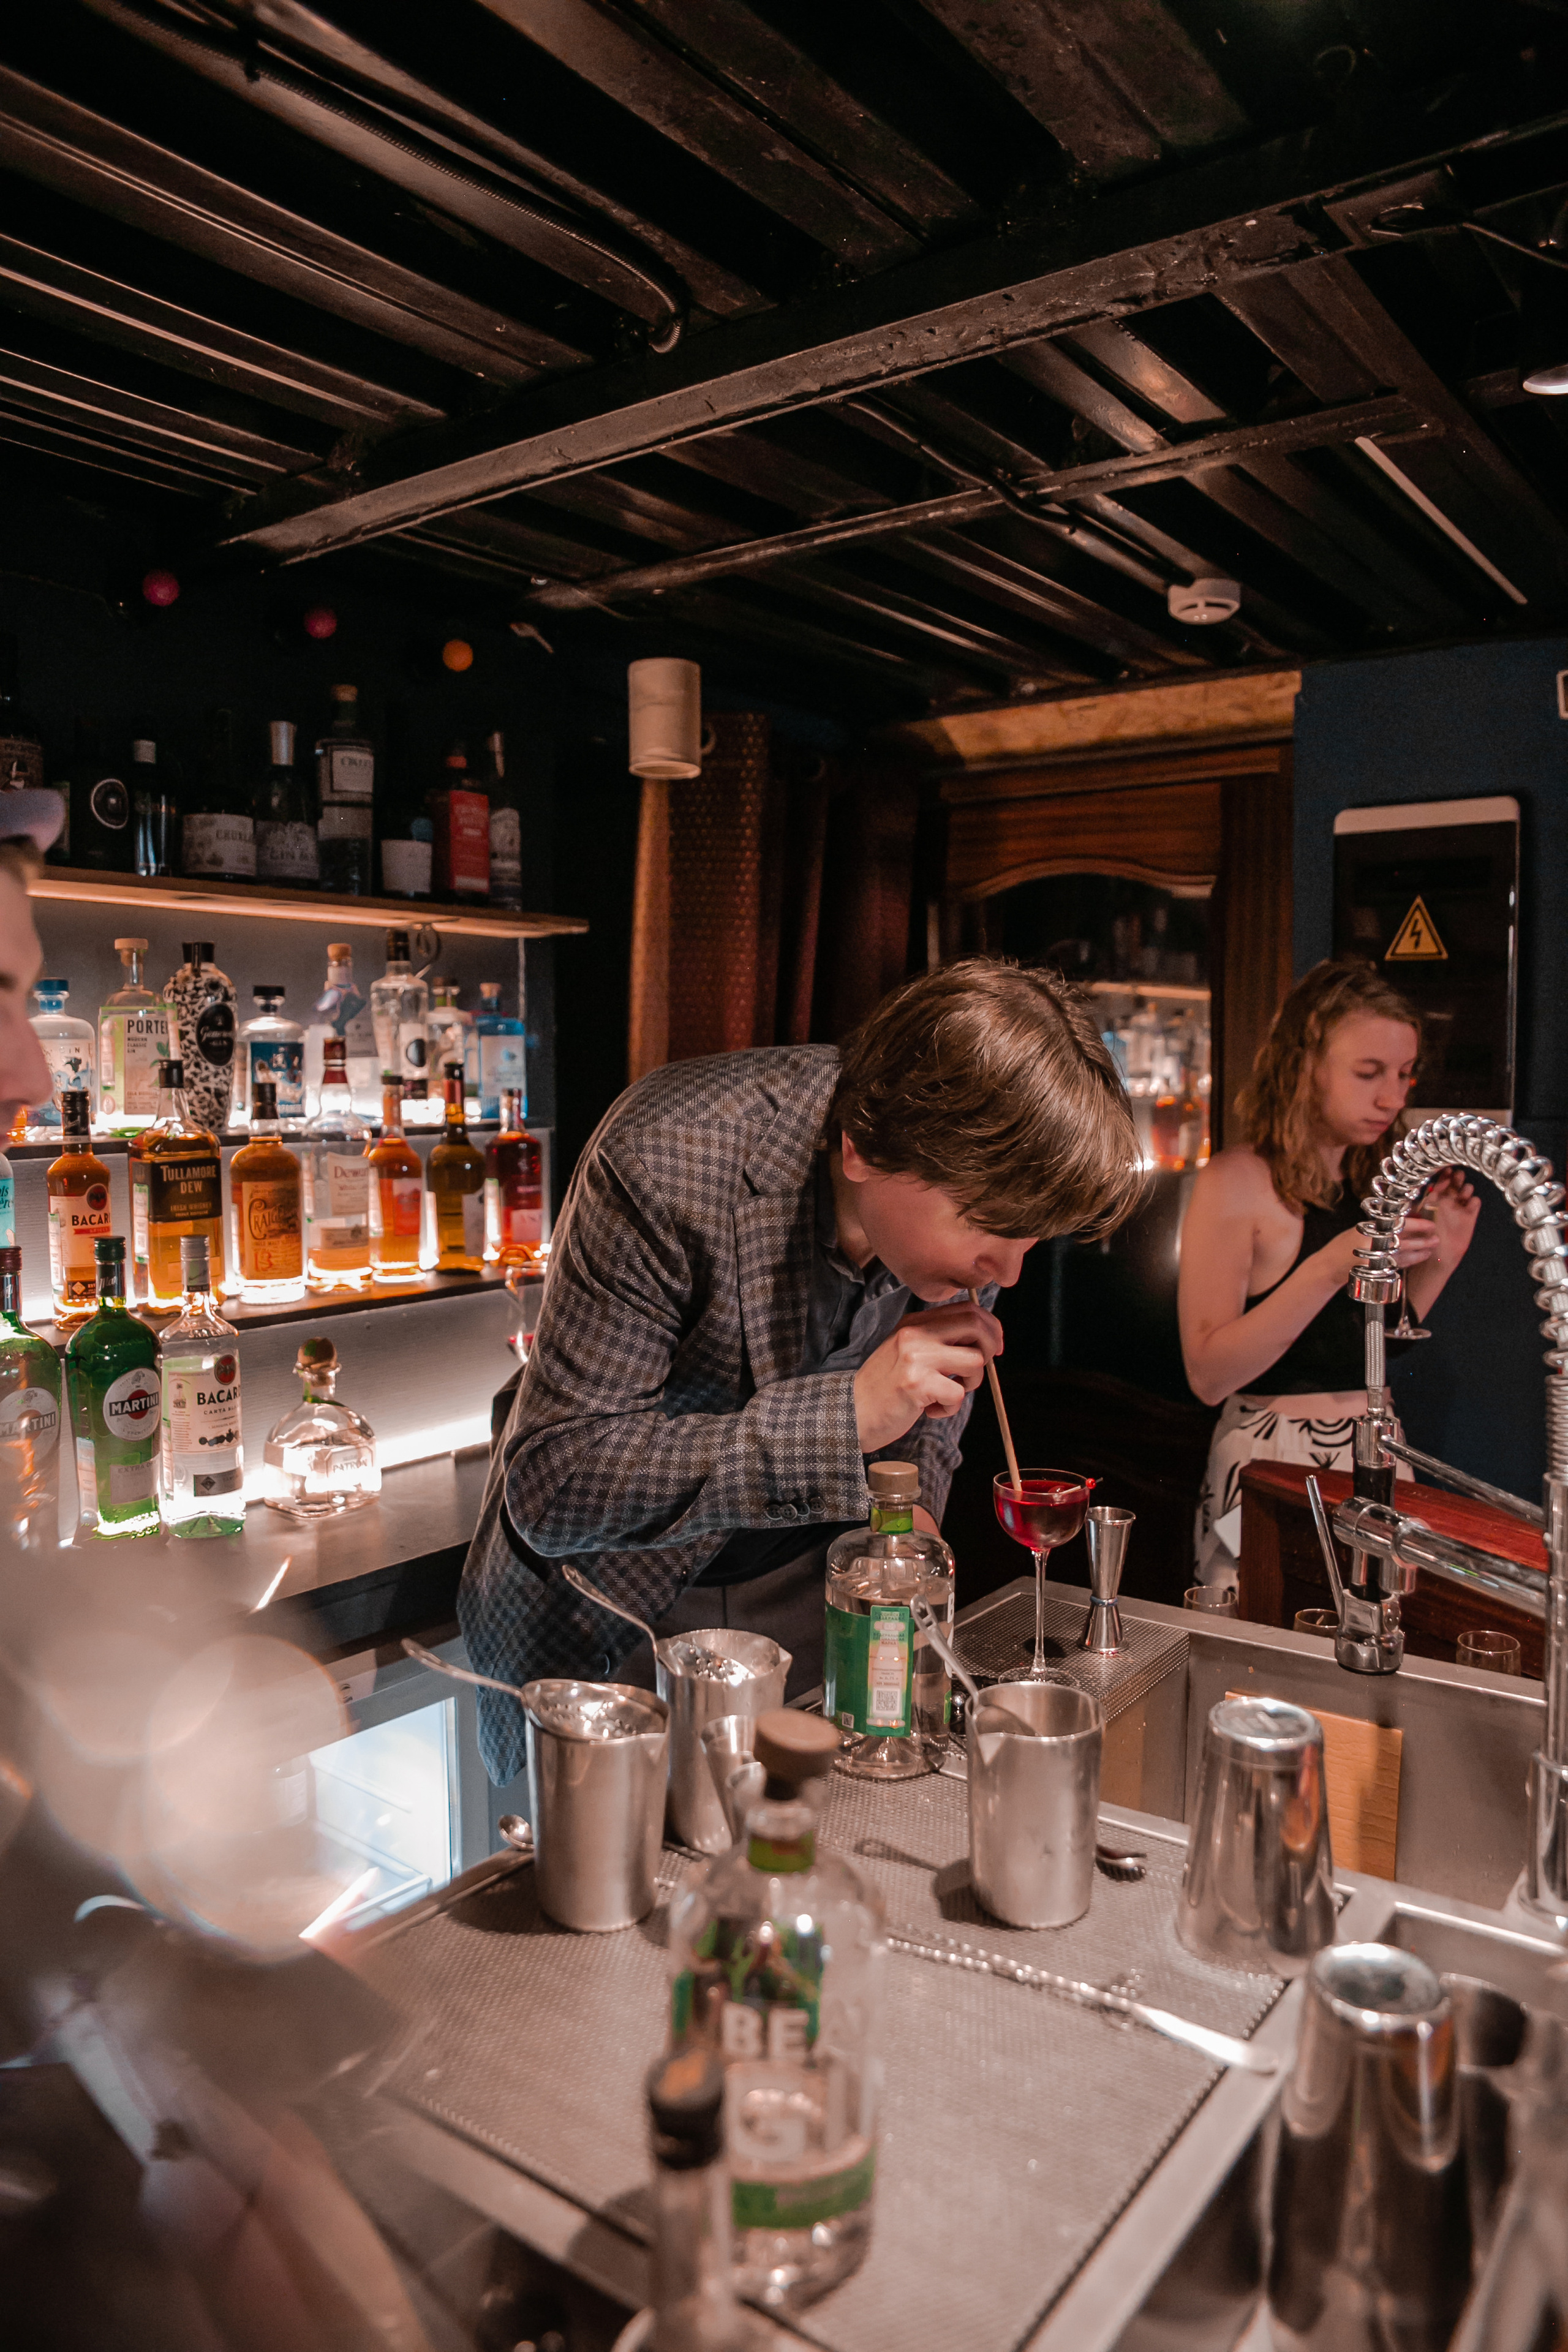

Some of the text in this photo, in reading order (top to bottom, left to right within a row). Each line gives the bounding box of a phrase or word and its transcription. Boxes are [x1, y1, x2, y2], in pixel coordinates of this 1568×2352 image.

[160, 1165, 216, 1182] TULLAMORE
[180, 1180, 202, 1194] DEW
[72, 1212, 110, 1226] BACAR
[111, 1393, 158, 1415] MARTINI
[118, 1464, 145, 1474] EXTRA
